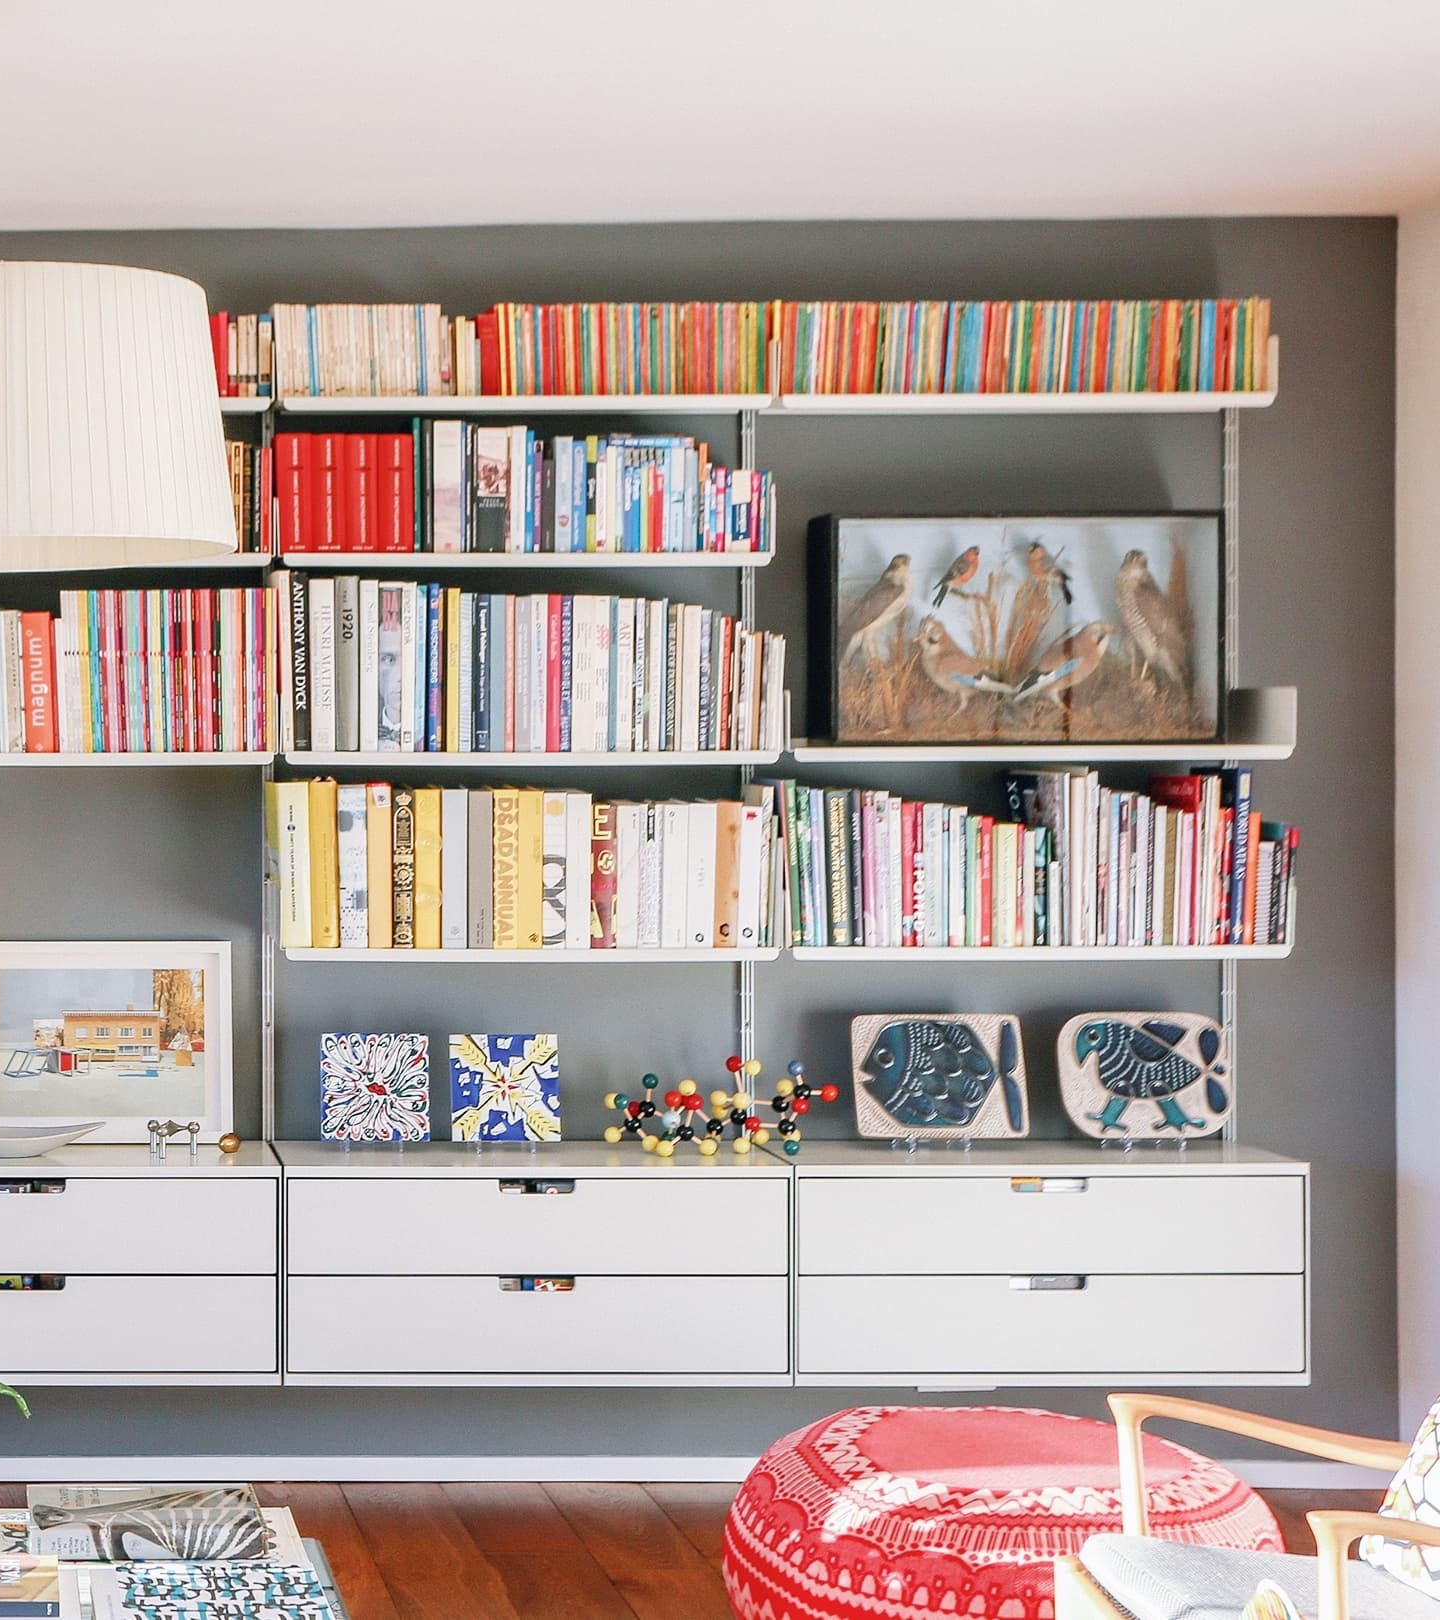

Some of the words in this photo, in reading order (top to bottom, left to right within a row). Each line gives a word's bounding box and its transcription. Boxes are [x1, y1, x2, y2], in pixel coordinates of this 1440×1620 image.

[293, 581, 305, 645] ANTHONY
[562, 600, 571, 617] THE
[321, 605, 331, 648] HENRI
[562, 619, 571, 645] BOOK
[619, 622, 631, 649] ART
[294, 647, 306, 674] VAN
[431, 618, 439, 684] RAUSCHENBERG
[562, 647, 571, 658] OF
[295, 676, 307, 711] DYCK
[321, 654, 332, 711] MATISSE
[497, 797, 514, 858] D&AD
[1237, 799, 1250, 846] WORLD
[1236, 847, 1249, 880] ATLAS
[497, 859, 514, 946] ANNUAL
[0, 1559, 21, 1584] NASH
